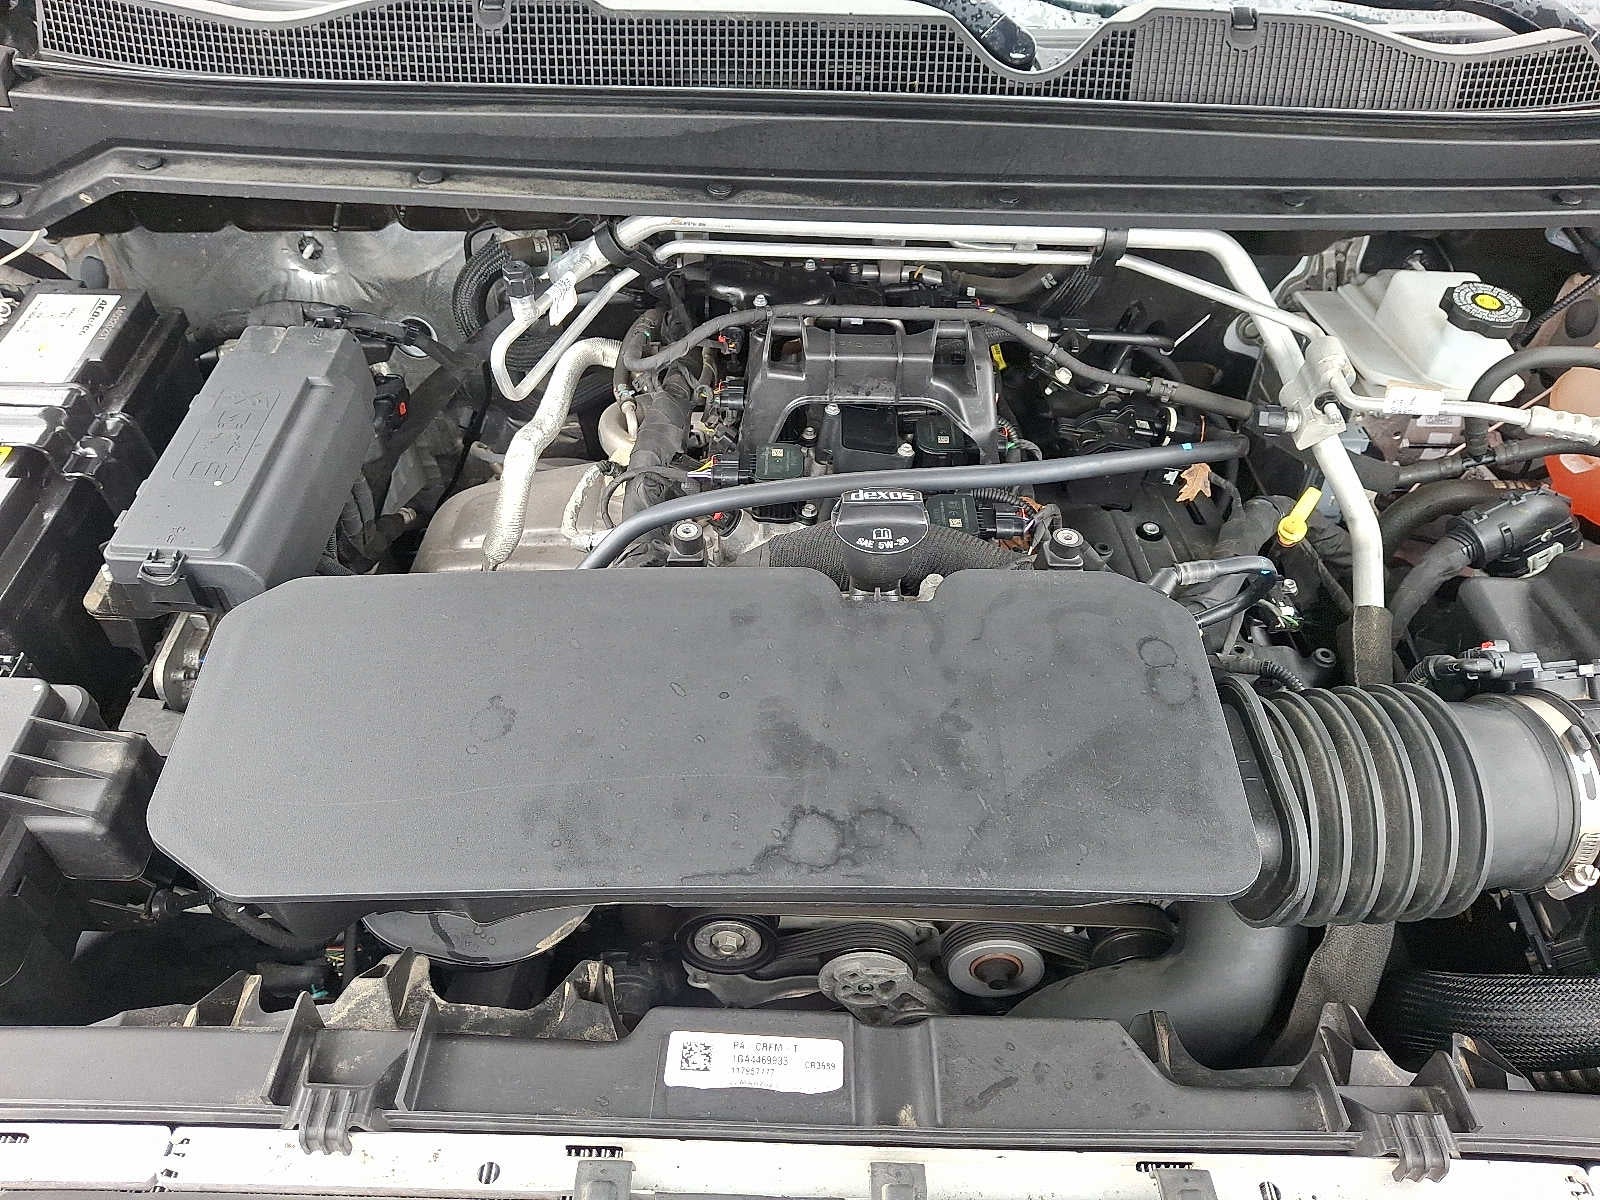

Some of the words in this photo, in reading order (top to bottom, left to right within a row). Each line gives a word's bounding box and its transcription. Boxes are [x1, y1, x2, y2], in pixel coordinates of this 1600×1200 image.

[850, 489, 916, 501] dexos
[856, 537, 875, 549] SAE
[878, 536, 910, 550] 5W-30
